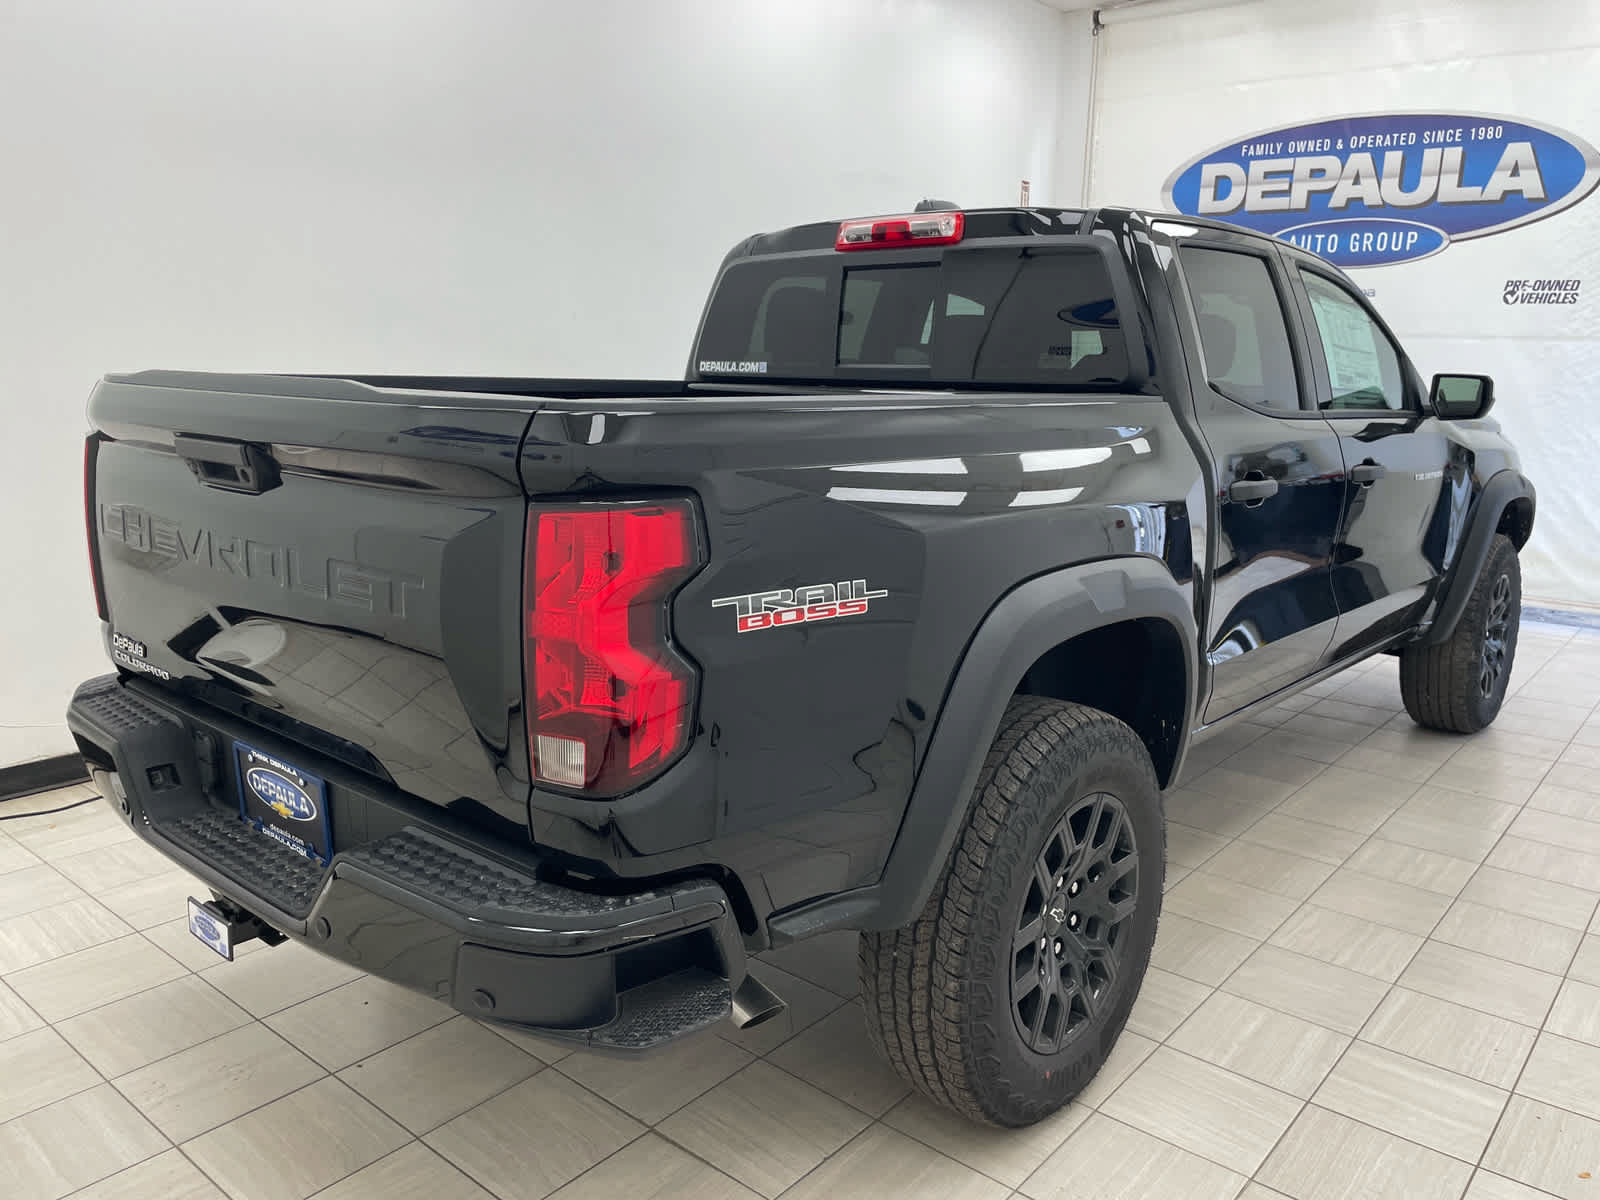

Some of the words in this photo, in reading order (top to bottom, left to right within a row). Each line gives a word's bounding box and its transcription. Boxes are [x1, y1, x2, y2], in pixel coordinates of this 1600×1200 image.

[1241, 142, 1283, 157] FAMILY
[1288, 139, 1330, 154] OWNED
[1336, 139, 1344, 150] &
[1350, 132, 1416, 149] OPERATED
[1423, 129, 1463, 144] SINCE
[1470, 126, 1503, 140] 1980
[1197, 142, 1548, 215] DEPAULA
[1350, 231, 1418, 252] GROUP
[1504, 279, 1581, 292] PRE-OWNED
[1520, 292, 1579, 305] VEHICLES
[699, 361, 760, 373] DEPAULA.COM
[101, 502, 425, 619] CHEVROLET
[712, 578, 888, 616] TRAIL
[738, 599, 868, 633] BOSS
[113, 633, 143, 657] DePaula
[115, 649, 170, 680] COLORADO
[252, 773, 311, 817] DEPAULA
